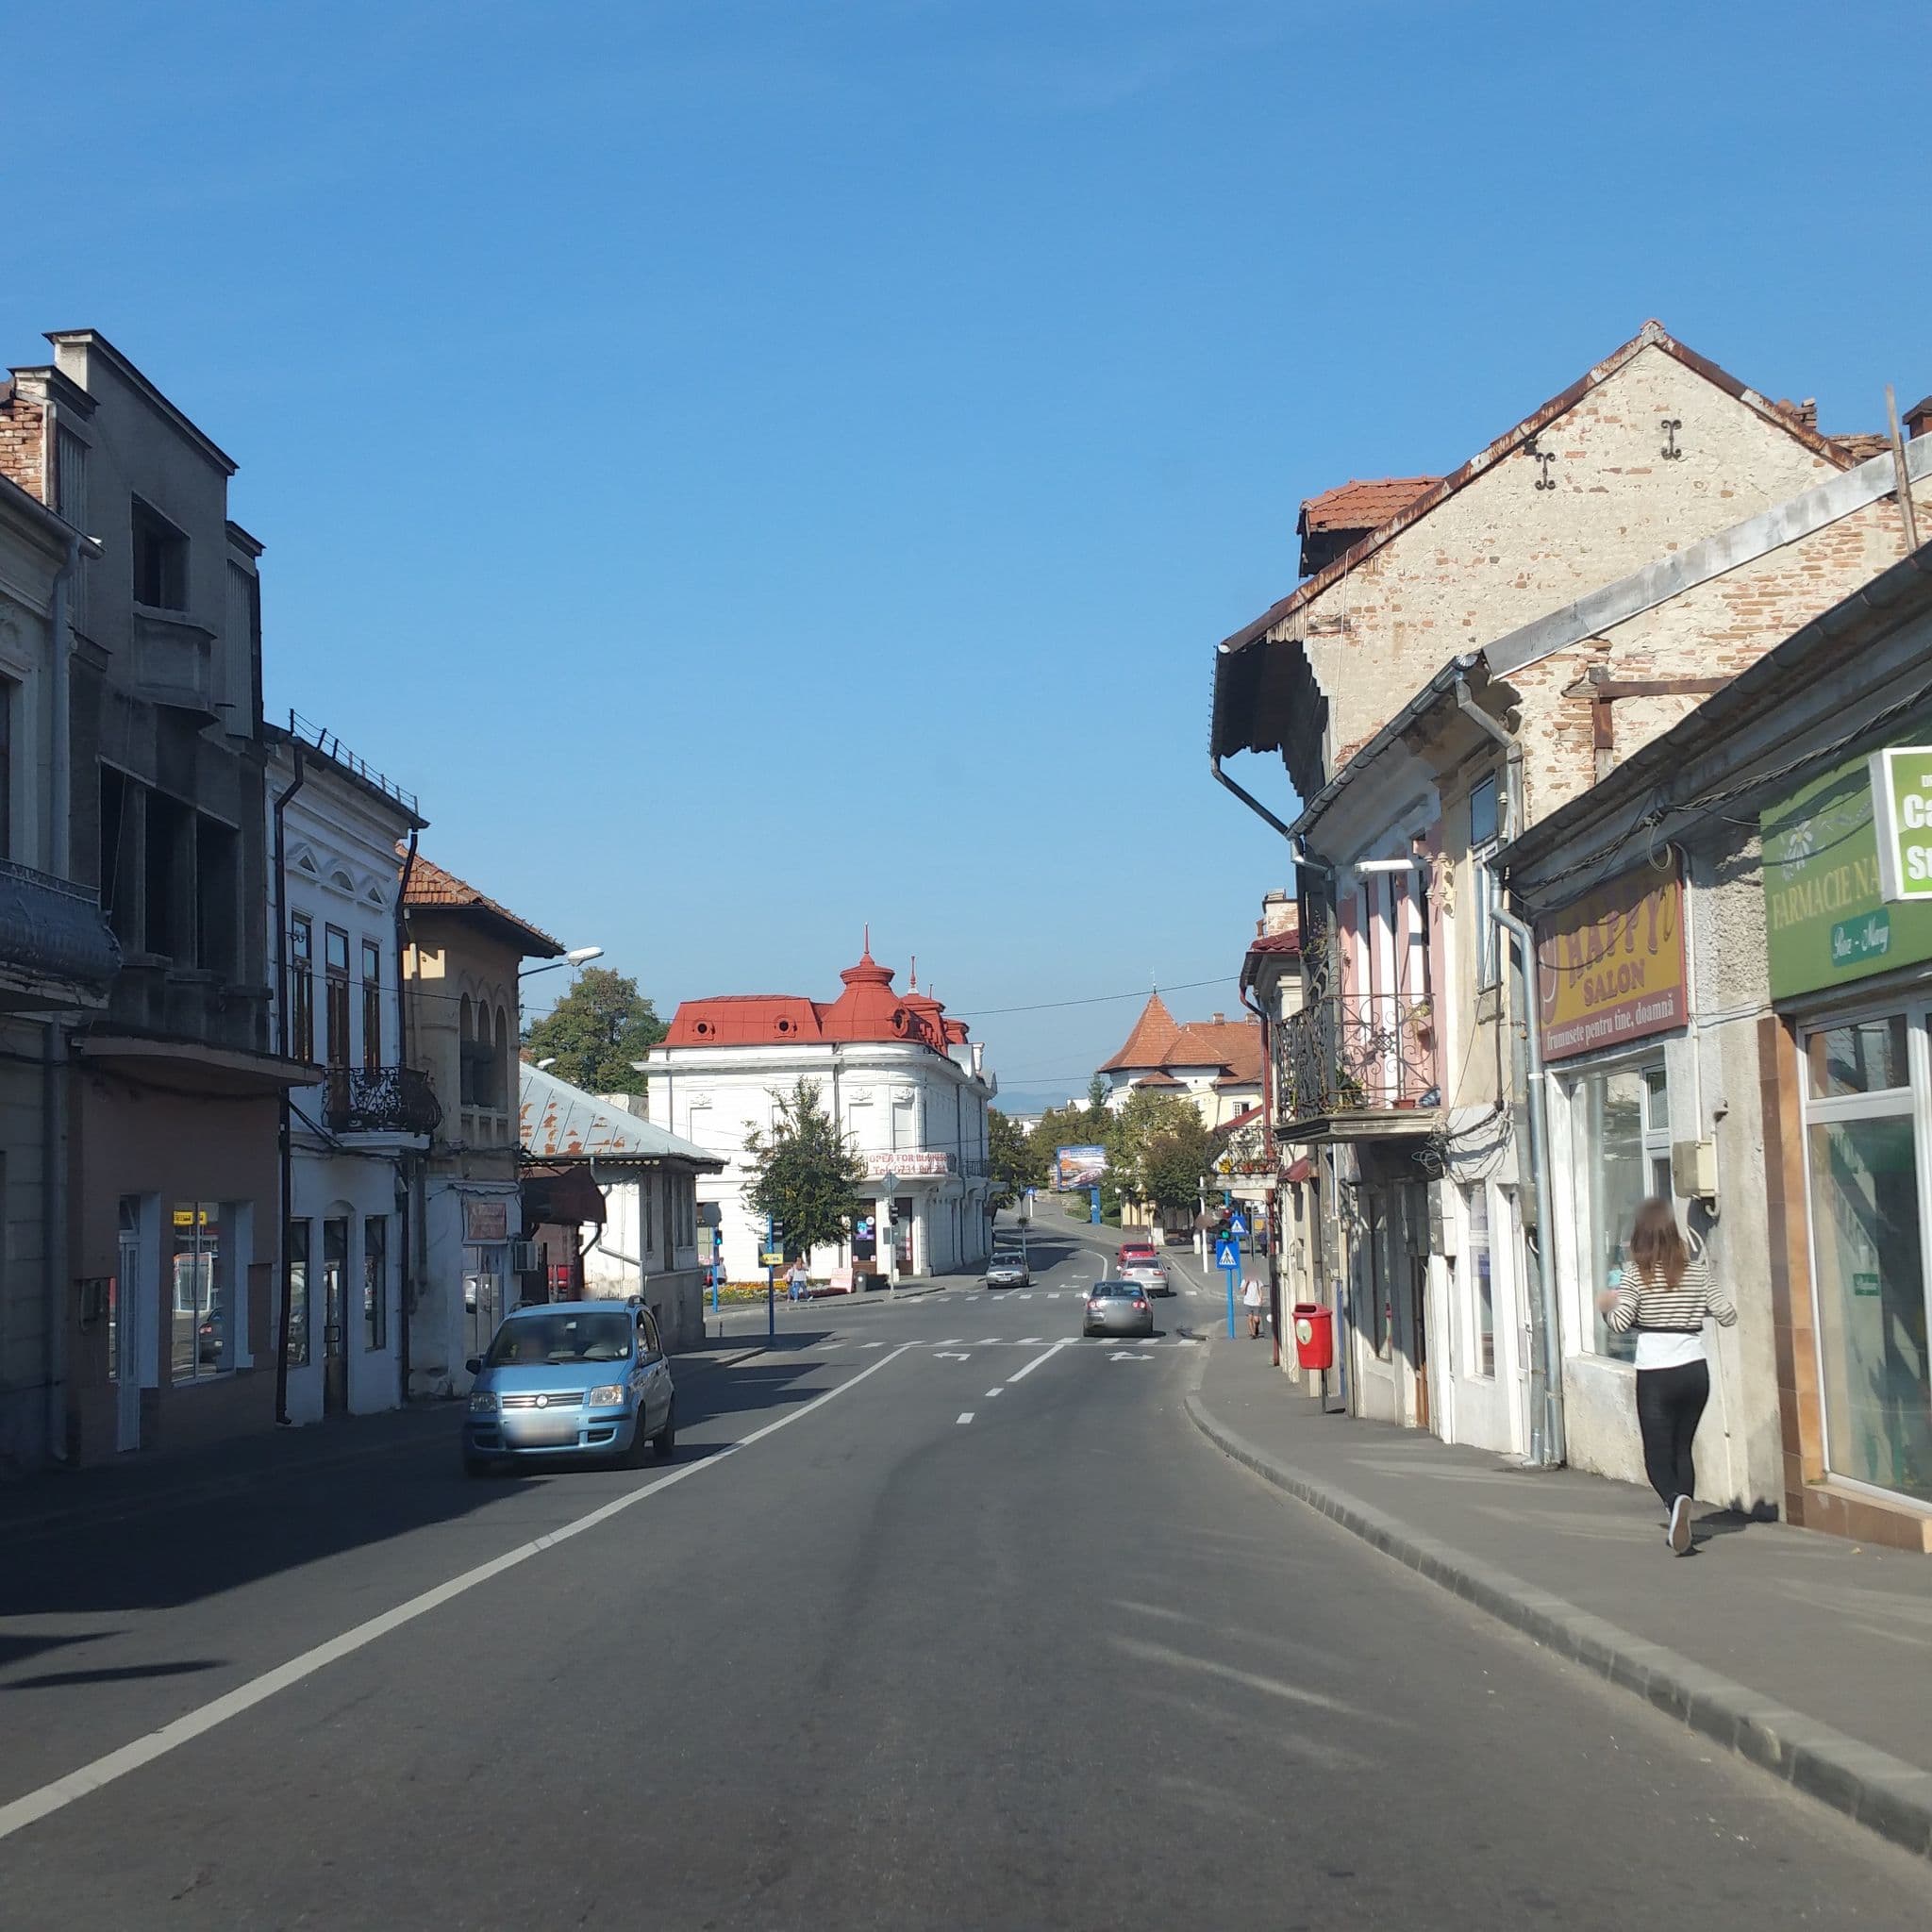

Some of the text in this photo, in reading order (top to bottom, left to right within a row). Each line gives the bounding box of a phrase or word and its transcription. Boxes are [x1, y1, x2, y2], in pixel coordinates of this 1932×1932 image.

[1773, 865, 1853, 930] FARMACIE
[1584, 958, 1644, 1007] SALON
[1585, 1017, 1613, 1046] pentru
[1636, 991, 1674, 1025] doamnă
[896, 1154, 914, 1162] FOR
